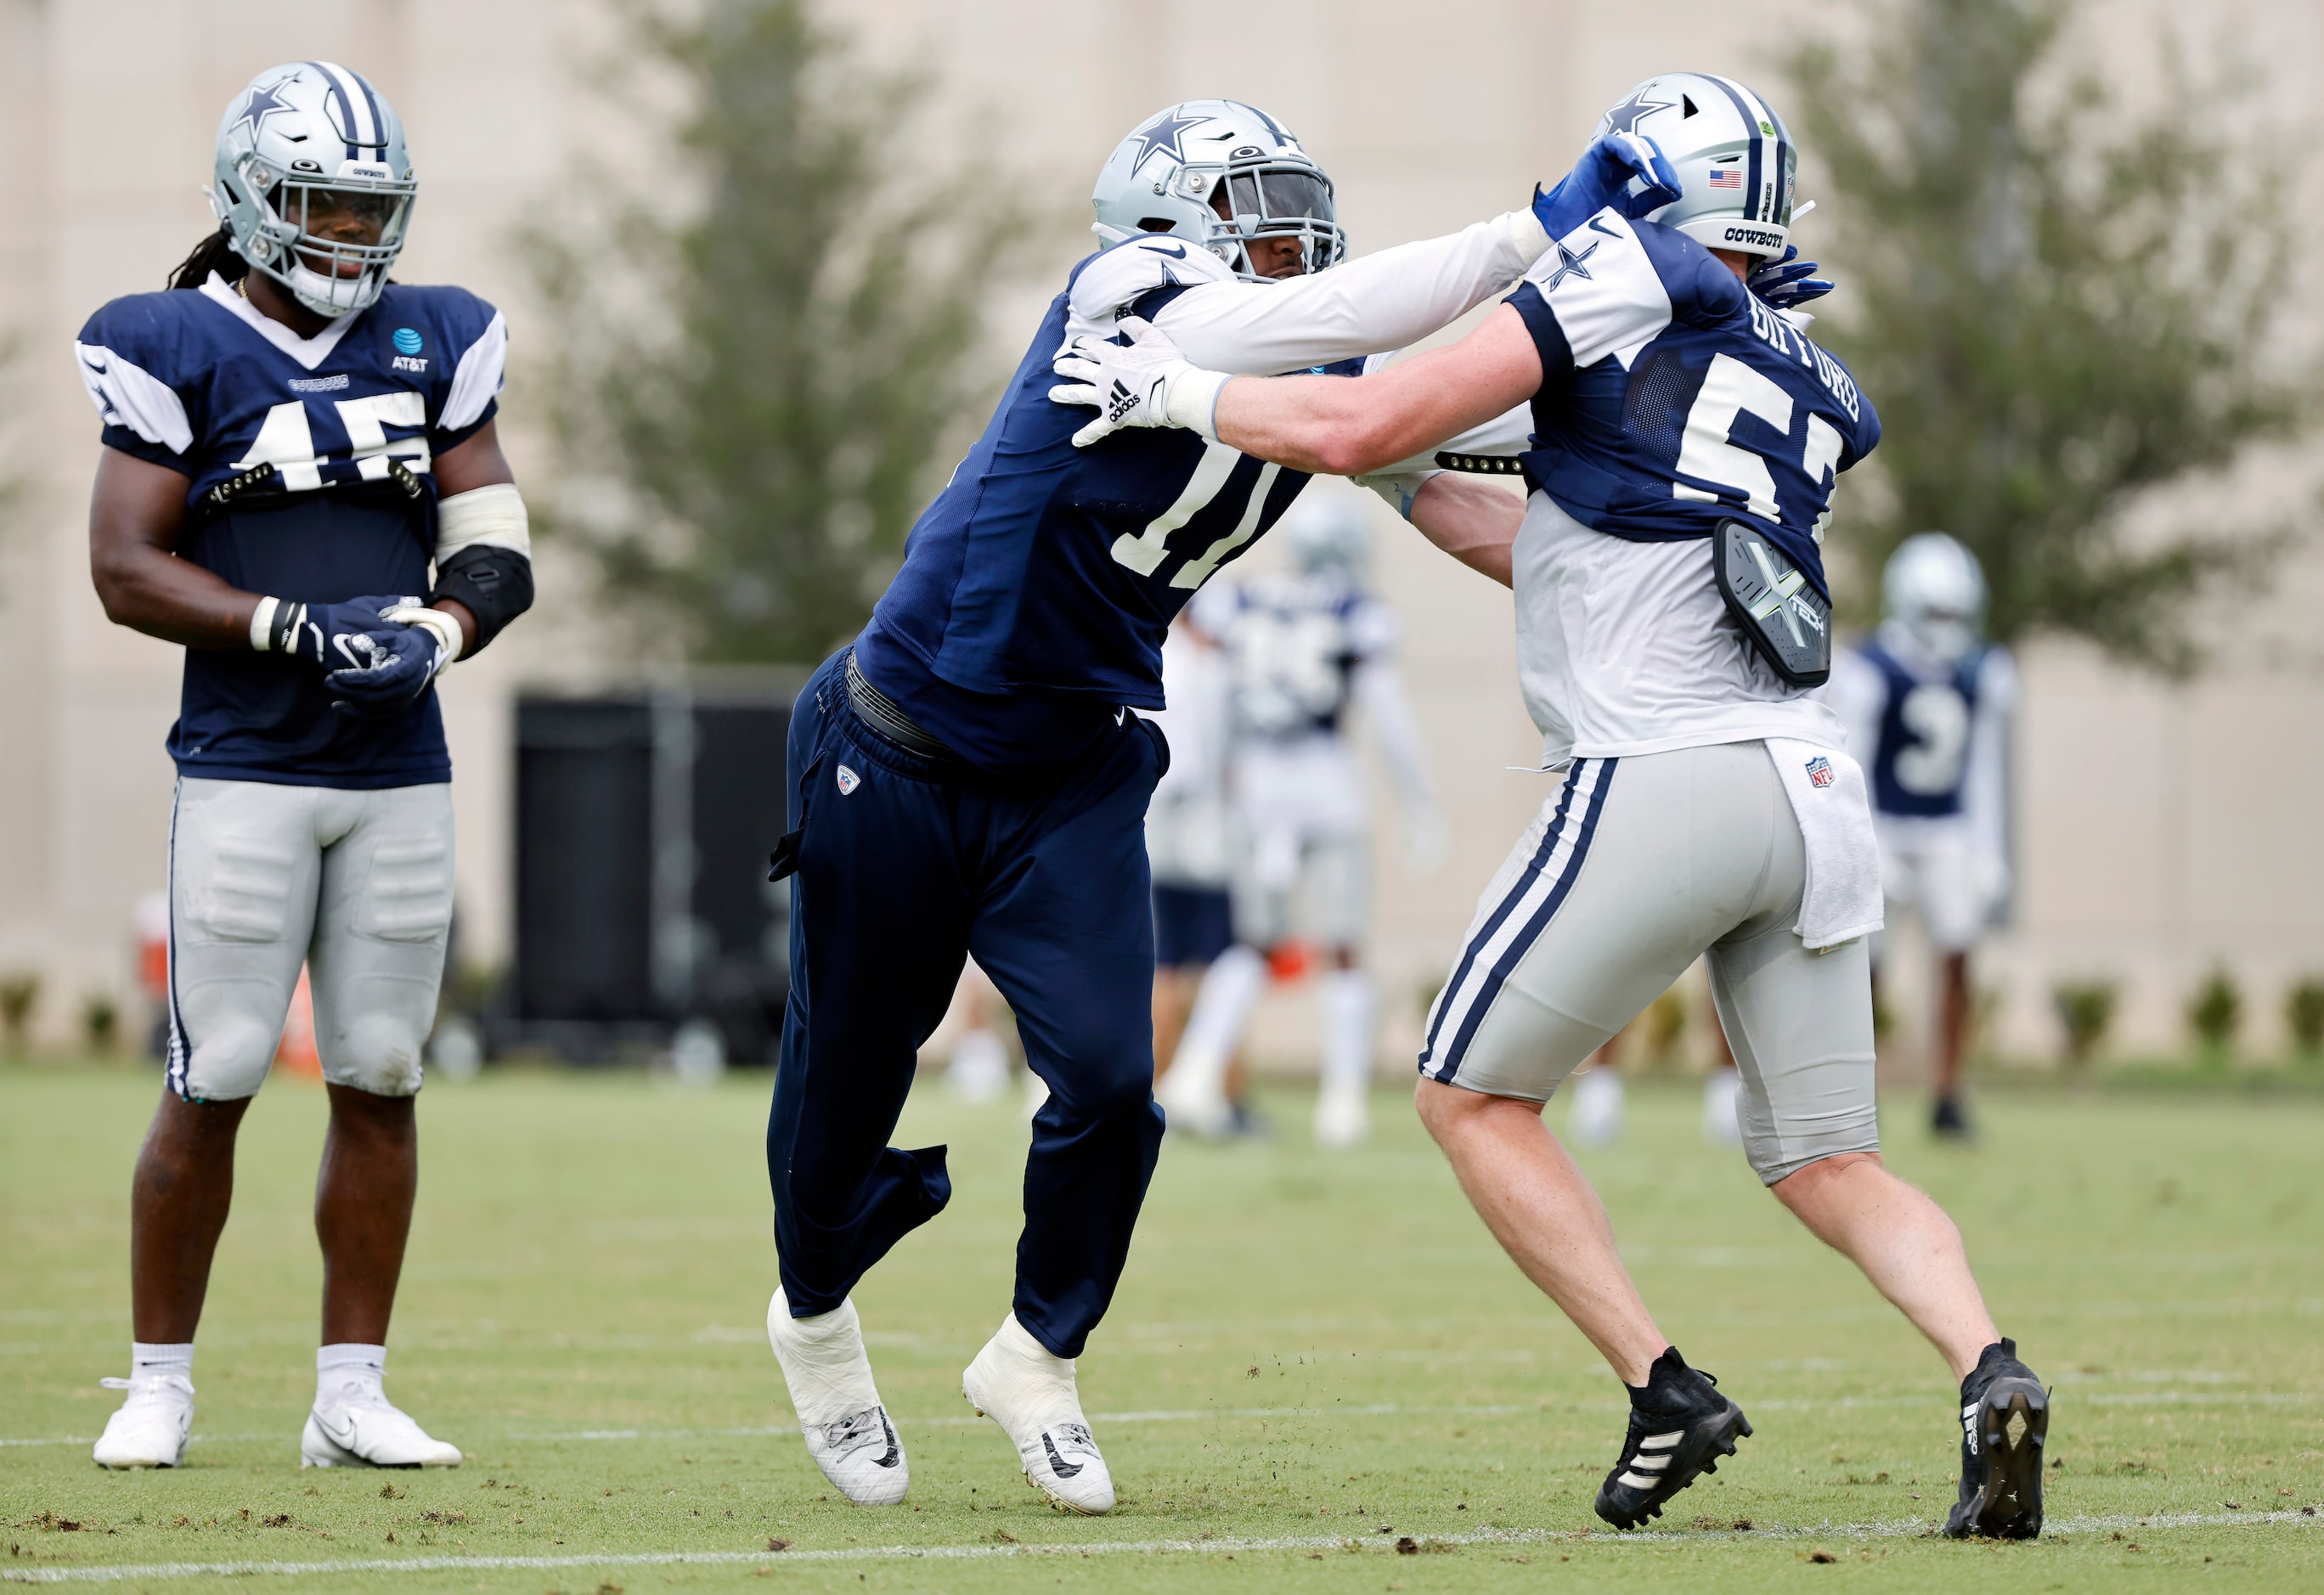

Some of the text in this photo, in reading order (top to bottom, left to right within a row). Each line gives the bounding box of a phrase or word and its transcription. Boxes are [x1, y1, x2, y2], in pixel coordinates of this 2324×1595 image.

[1724, 227, 1783, 249] COWBOYS
[392, 356, 428, 373] AT&T
[1109, 394, 1141, 422] adidas
[228, 391, 432, 493] 45
[1892, 685, 1969, 798] 3
[1811, 768, 1833, 786] NFL
